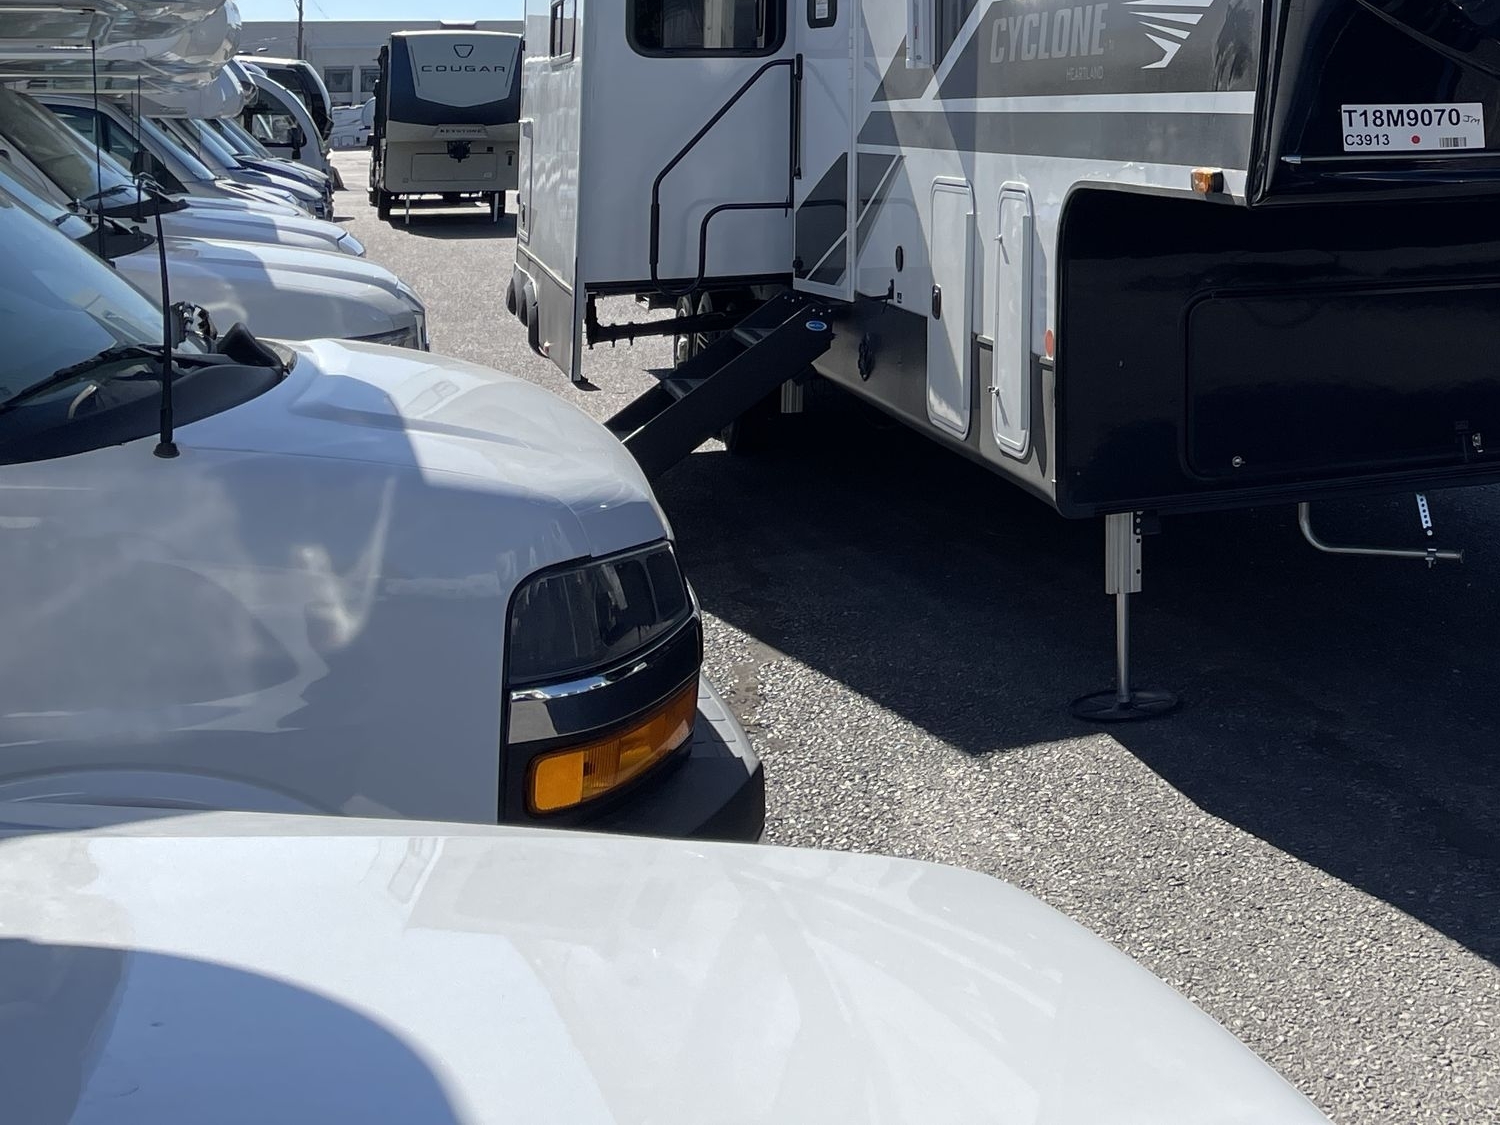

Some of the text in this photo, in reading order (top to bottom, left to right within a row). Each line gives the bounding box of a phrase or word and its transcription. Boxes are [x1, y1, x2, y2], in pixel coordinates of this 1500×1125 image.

[990, 3, 1109, 64] CYCLONE
[421, 65, 505, 73] COUGAR
[1066, 65, 1104, 81] HEARTLAND
[1343, 108, 1461, 127] T18M9070
[1344, 133, 1390, 146] C3913
